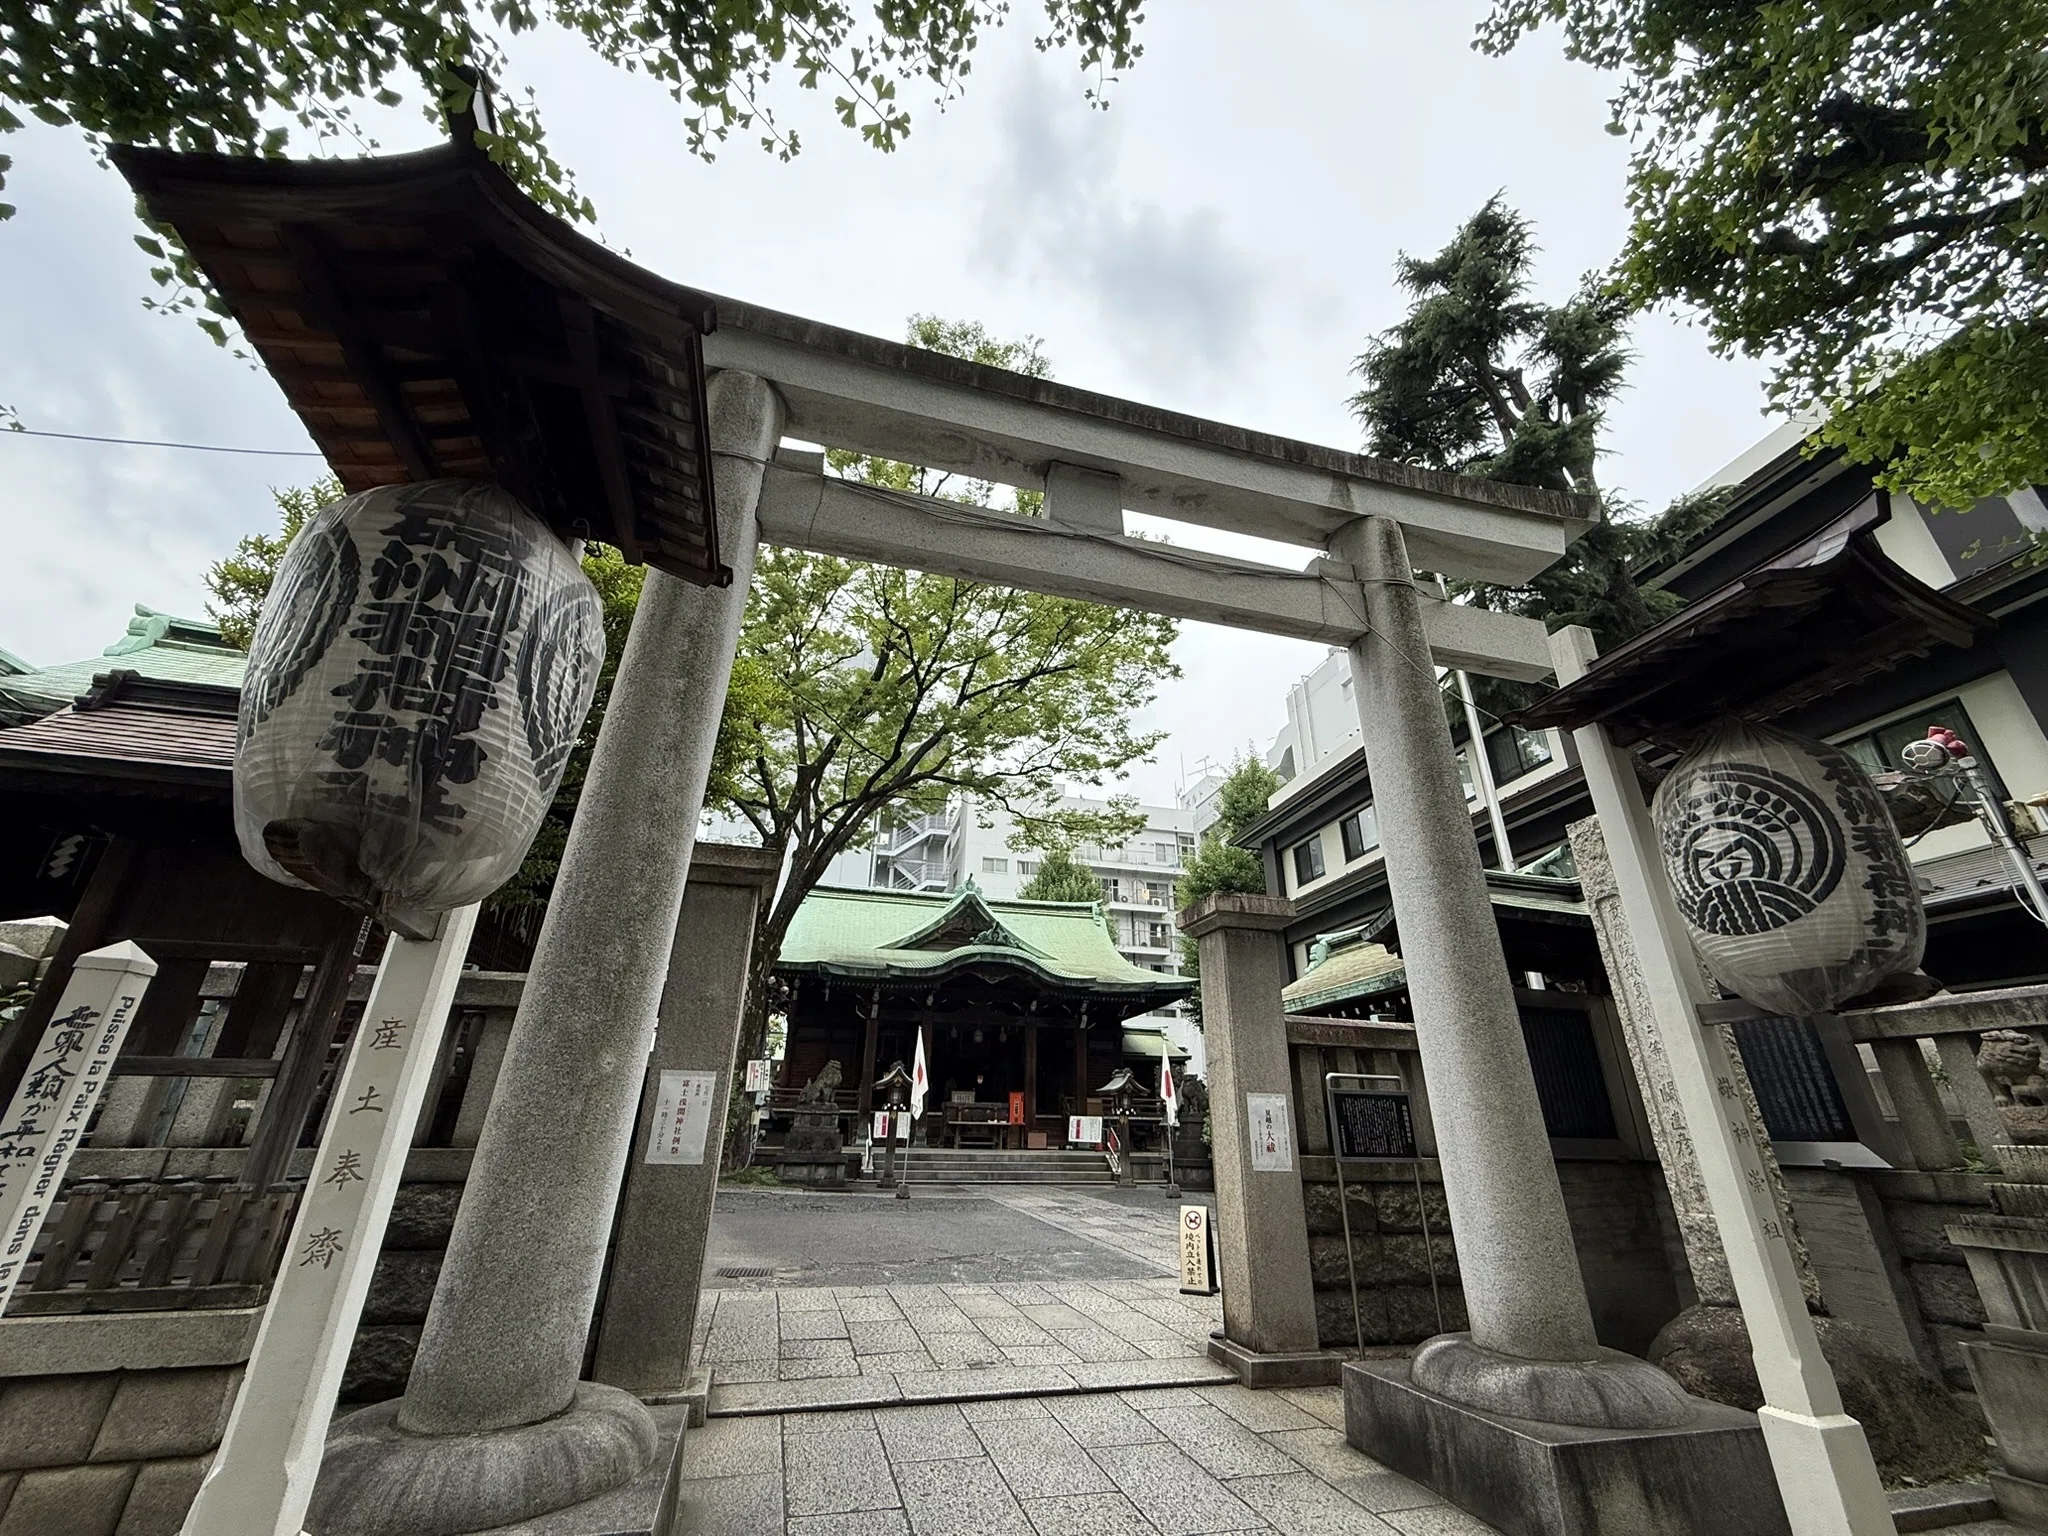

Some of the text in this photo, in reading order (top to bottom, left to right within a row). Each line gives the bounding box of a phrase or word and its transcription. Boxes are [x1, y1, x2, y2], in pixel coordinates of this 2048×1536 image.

[98, 996, 136, 1054] Puisse
[88, 1060, 107, 1075] la
[66, 1081, 98, 1122] Paix
[7, 1205, 41, 1255] dans
[1185, 1232, 1197, 1286] 境内立入禁止
